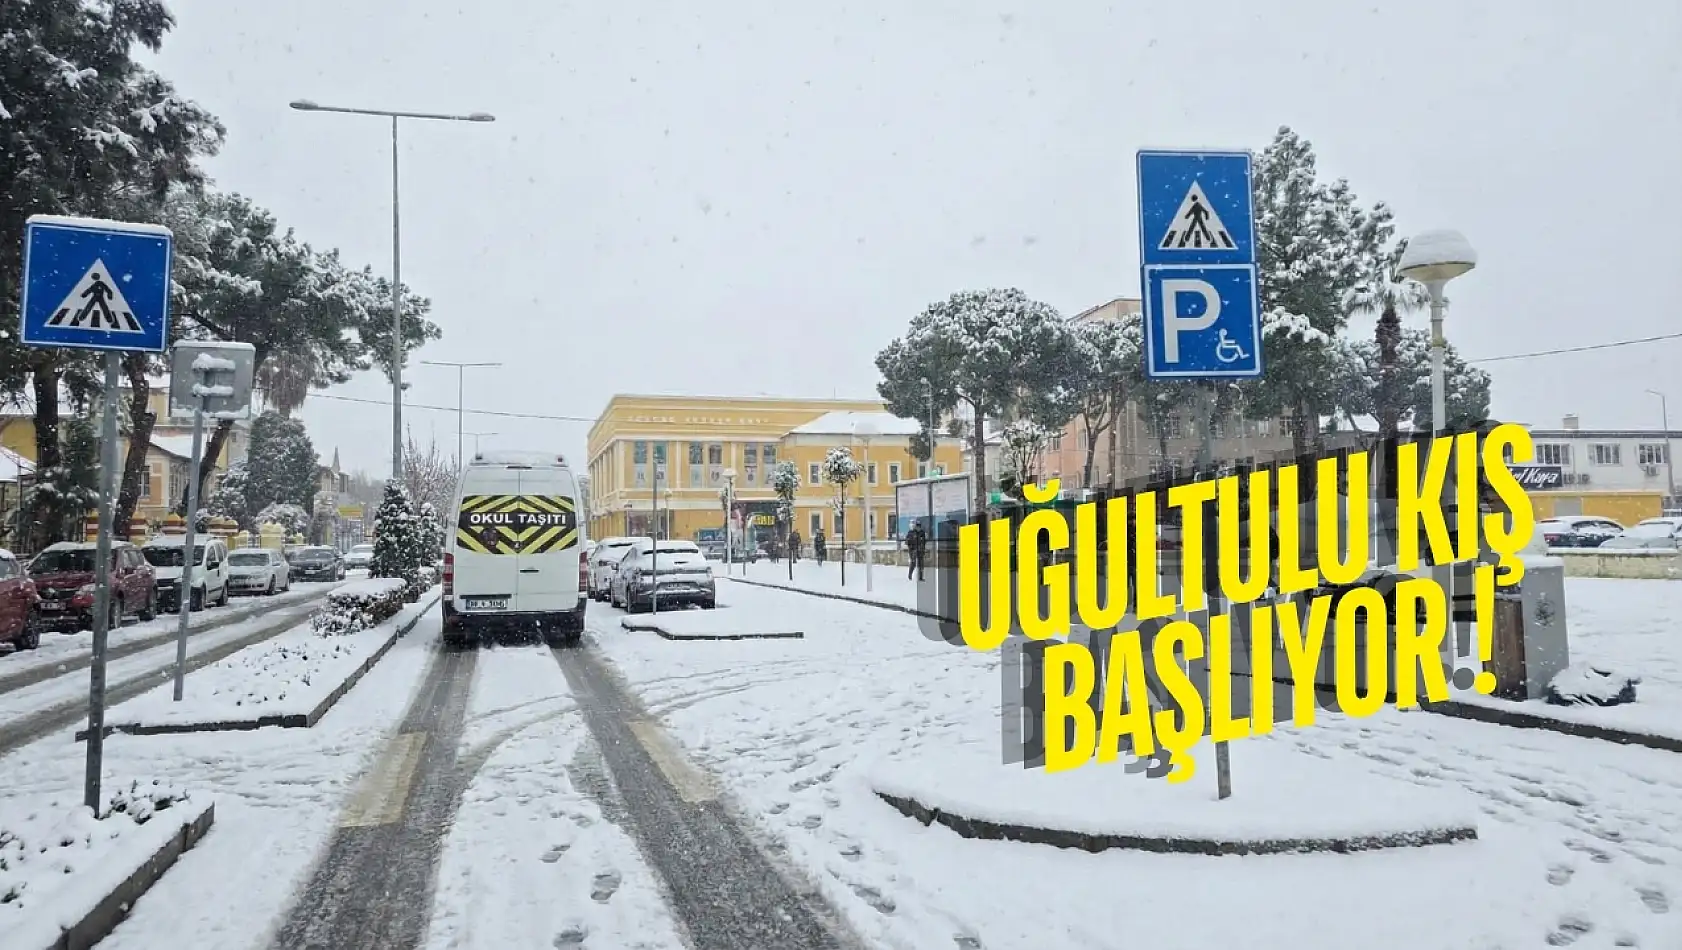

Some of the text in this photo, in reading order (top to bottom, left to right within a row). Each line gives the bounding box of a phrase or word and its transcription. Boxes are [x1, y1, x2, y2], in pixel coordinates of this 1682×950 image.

[1161, 279, 1221, 364] P
[470, 513, 567, 526] OKUL TAŞITI
